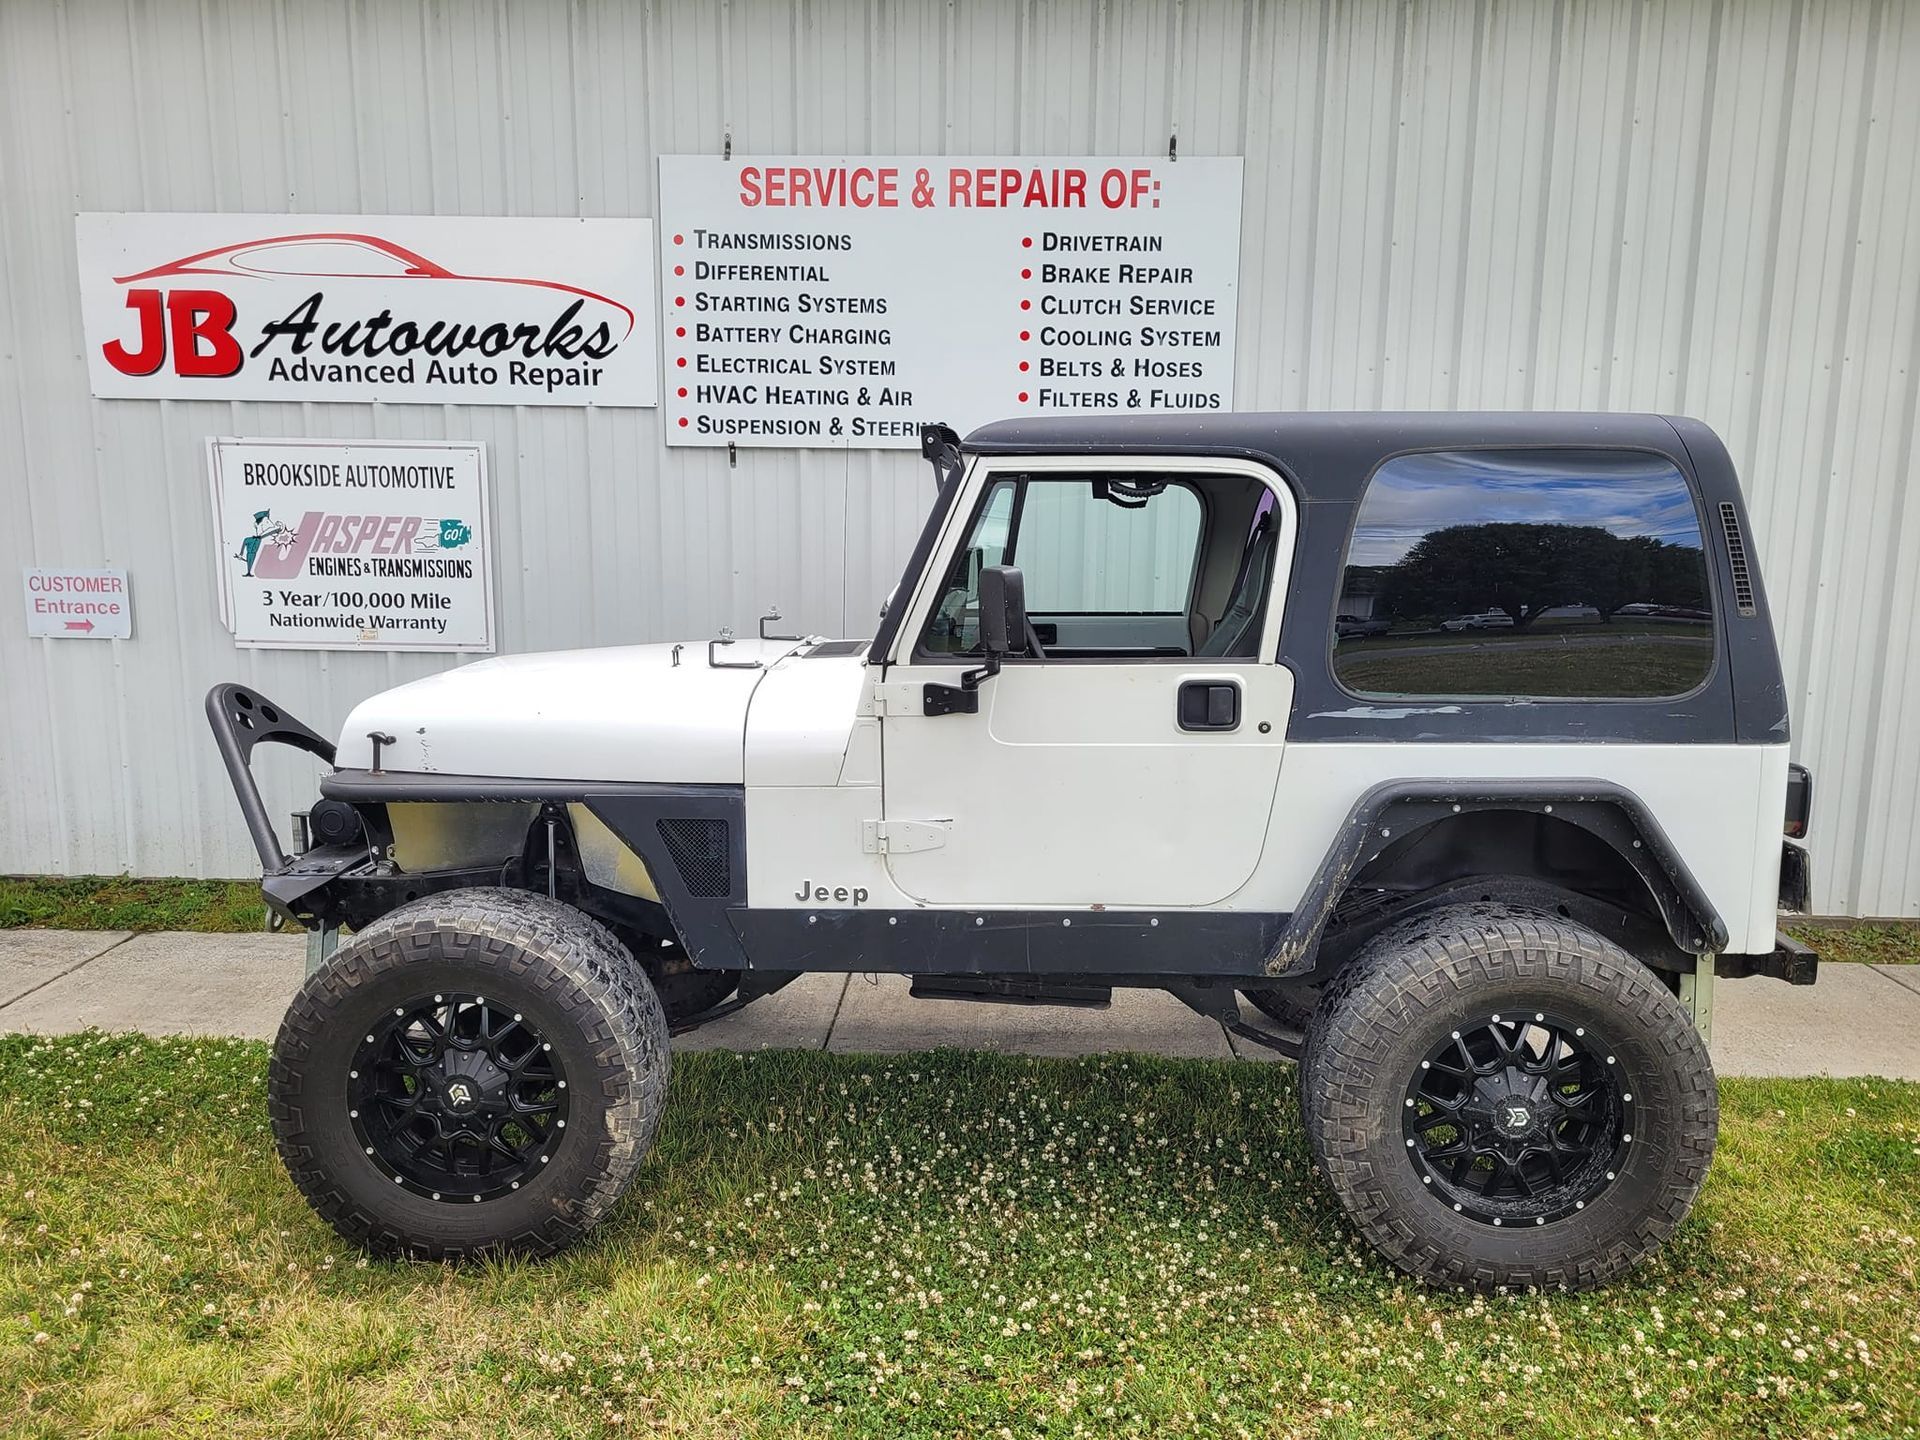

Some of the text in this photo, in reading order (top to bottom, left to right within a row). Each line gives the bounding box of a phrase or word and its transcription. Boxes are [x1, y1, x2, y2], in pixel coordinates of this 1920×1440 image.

[741, 167, 1160, 208] SERVICE & REPAIR OF:
[694, 230, 851, 250] TRANSMISSIONS
[1043, 232, 1161, 251] DRIVETRAIN
[696, 261, 829, 281] DIFFERENTIAL
[1043, 264, 1192, 283] BRAKE REPAIR
[696, 292, 886, 314] STARTING SYSTEMS
[1041, 295, 1214, 315] CLUTCH SERVICE
[102, 289, 619, 378] JB Autoworks
[697, 324, 890, 345] BATTERY CHARGING
[1041, 327, 1220, 346] COOLING SYSTEM
[268, 357, 603, 393] Advanced Auto Repair
[697, 354, 895, 375] ELECTRICAL SYSTEM
[1041, 358, 1202, 377] BELTS & HOSES
[697, 385, 912, 406] HVAC HEATING & AIR
[1040, 389, 1219, 408] FILTERS & FLUIDS
[698, 415, 948, 436] SUSPENSION & STEERI
[244, 464, 455, 489] BROOKSIDE AUTOMOTIVE
[444, 528, 463, 541] GO!
[254, 511, 422, 580] JASPER
[310, 557, 472, 578] ENGINES & TRANSMISSIONS
[29, 576, 121, 592] CUSTOMER
[35, 598, 120, 614] Entrance
[263, 591, 451, 609] 3 Year/100,000 Mile
[270, 613, 364, 628] Nationwide
[370, 615, 446, 634] Warranty
[795, 881, 868, 906] Jeep
